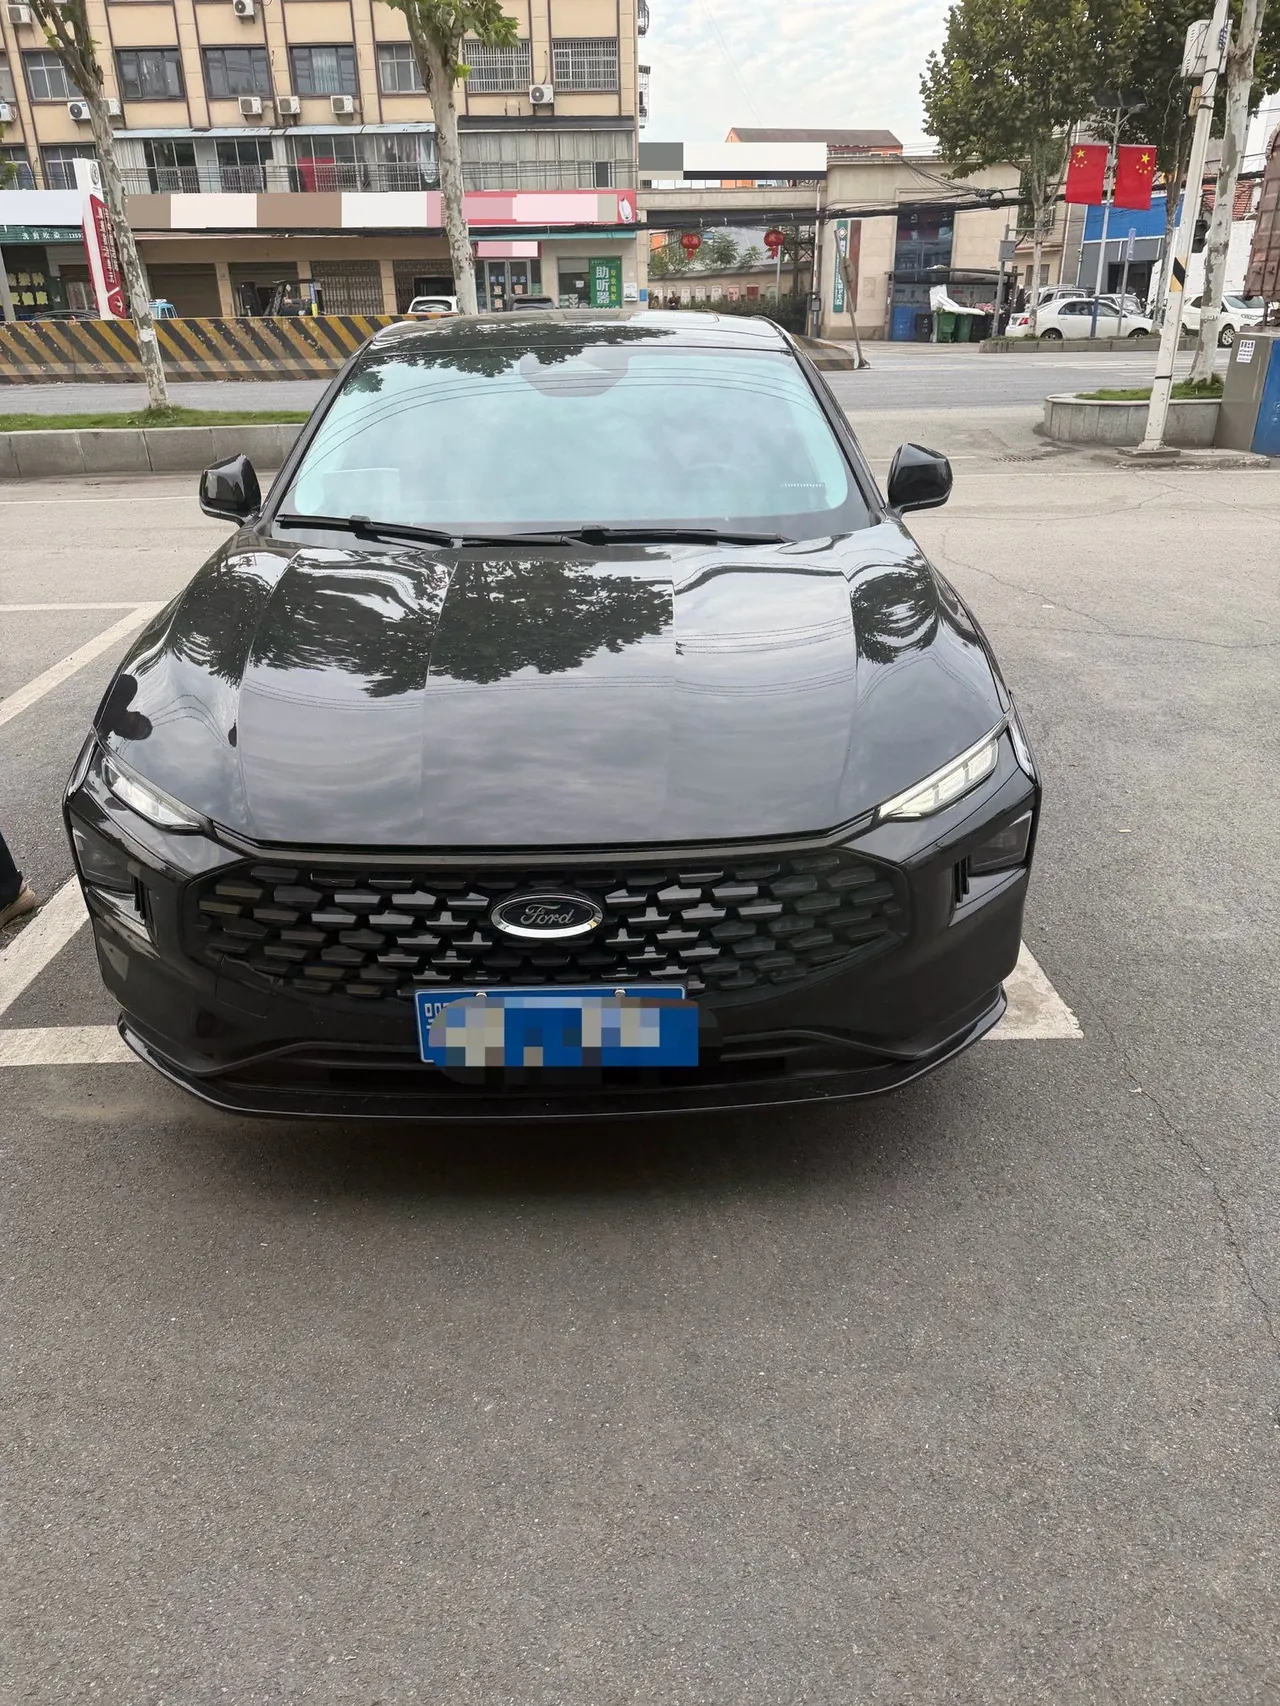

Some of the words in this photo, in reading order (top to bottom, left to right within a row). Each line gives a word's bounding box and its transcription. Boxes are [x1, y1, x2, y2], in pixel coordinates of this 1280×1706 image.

[595, 266, 610, 304] 助听器
[520, 904, 575, 925] Ford
